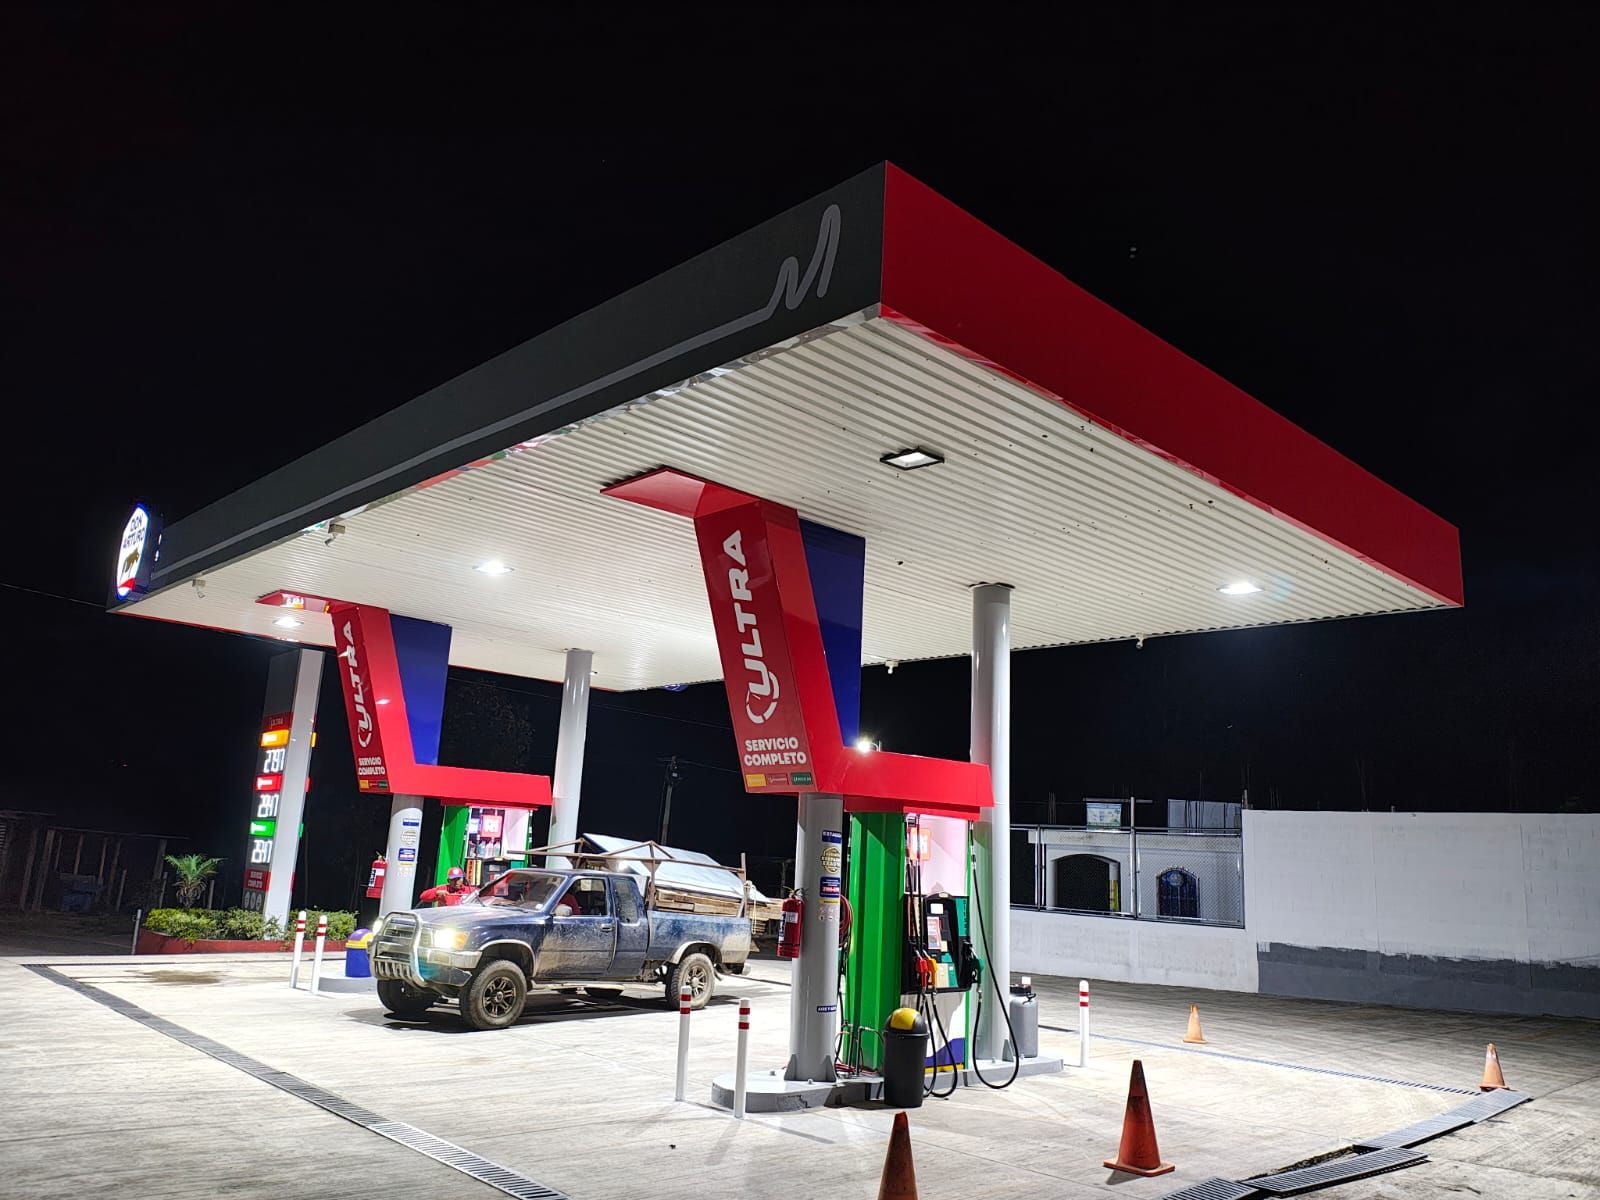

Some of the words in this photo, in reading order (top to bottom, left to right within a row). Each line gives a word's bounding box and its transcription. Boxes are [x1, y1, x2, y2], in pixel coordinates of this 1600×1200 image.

[722, 529, 771, 698] ULTRA
[343, 621, 370, 731] ULTRA
[745, 737, 799, 752] SERVICIO
[358, 757, 382, 766] SERVICIO
[744, 751, 807, 767] COMPLETO
[358, 766, 386, 776] COMPLETO
